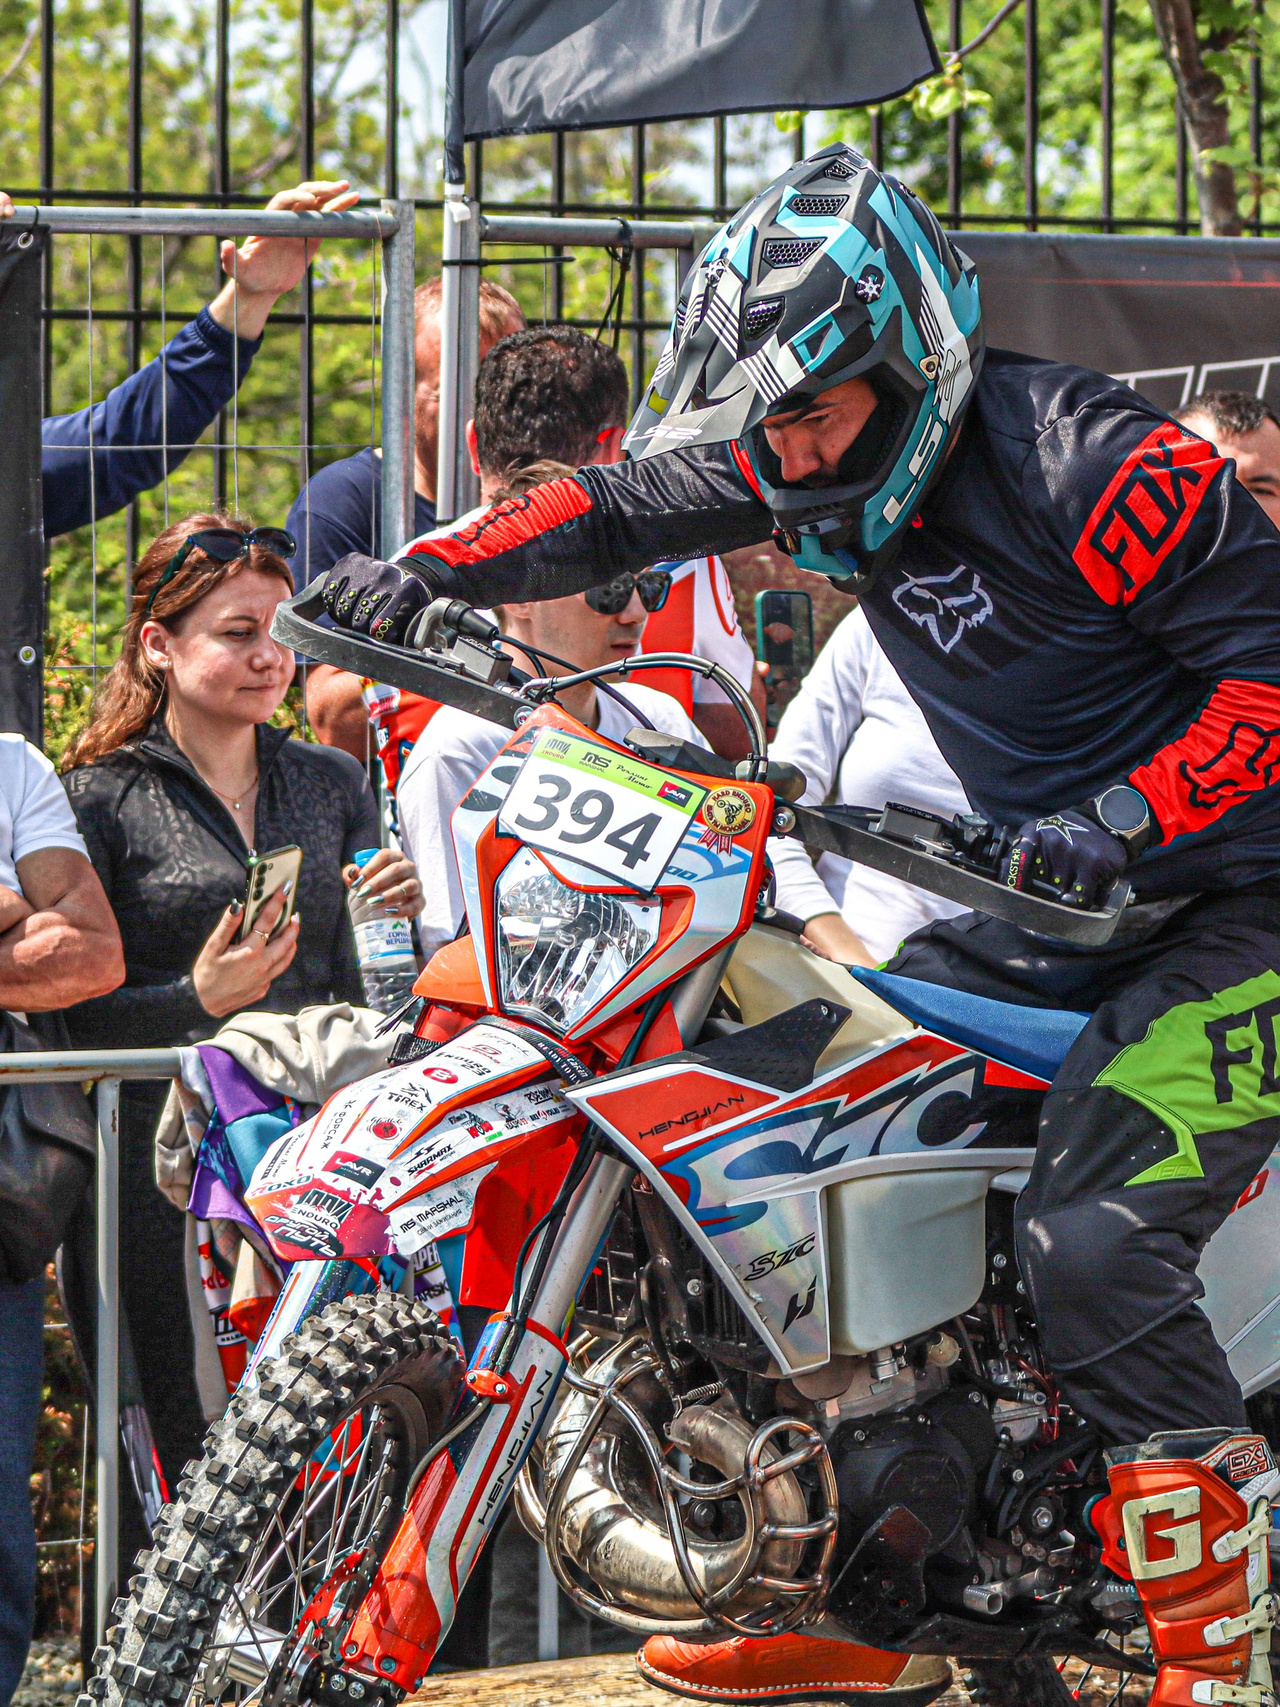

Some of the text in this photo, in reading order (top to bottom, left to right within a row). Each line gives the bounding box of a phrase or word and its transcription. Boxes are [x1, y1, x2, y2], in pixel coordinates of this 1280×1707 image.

[625, 424, 703, 442] LS2
[1089, 439, 1204, 591] FOX
[513, 773, 663, 871] 394
[637, 1093, 746, 1140] HENGJIAN
[334, 1157, 373, 1177] LAVR
[407, 1143, 453, 1177] SHARMAX
[263, 1215, 330, 1245] ДРУГОЙ
[290, 1207, 341, 1230] ENDURO
[400, 1195, 464, 1234] MS MARSHAL
[275, 1226, 338, 1258] ПУТЬ
[477, 1369, 554, 1526] HENGJIAN
[1122, 1486, 1203, 1581] G
